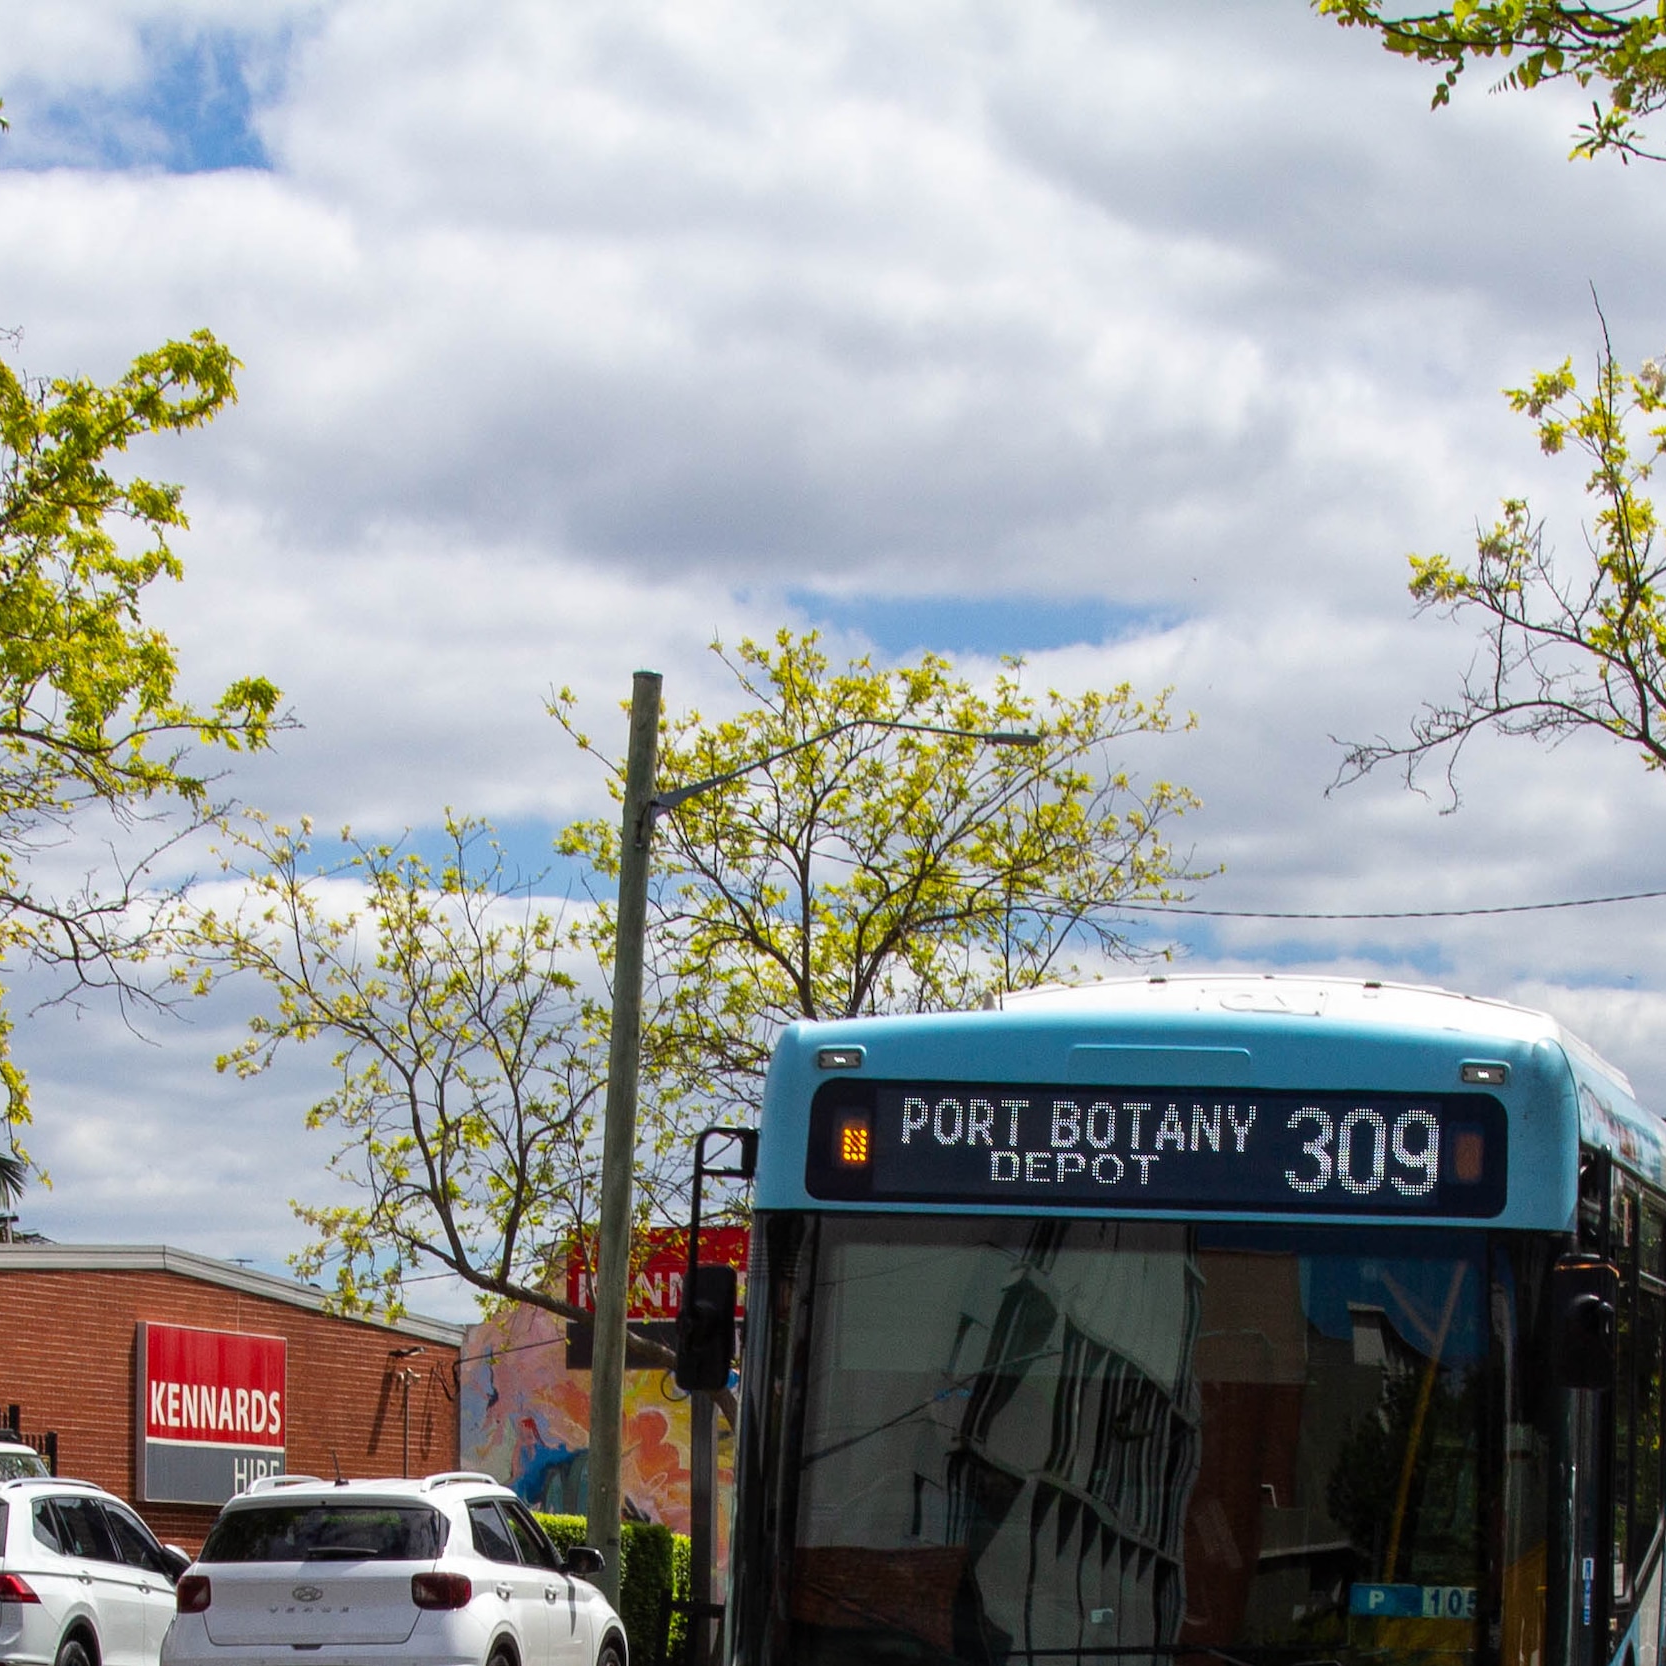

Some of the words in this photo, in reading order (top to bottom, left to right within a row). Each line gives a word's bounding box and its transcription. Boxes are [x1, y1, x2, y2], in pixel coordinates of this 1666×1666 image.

[900, 1096, 1030, 1147] PORT
[1049, 1100, 1258, 1154] BOTANY
[1283, 1105, 1440, 1196] 309
[989, 1150, 1160, 1186] DEPOT
[151, 1379, 282, 1435] KENNARDS
[1368, 1589, 1385, 1609] P
